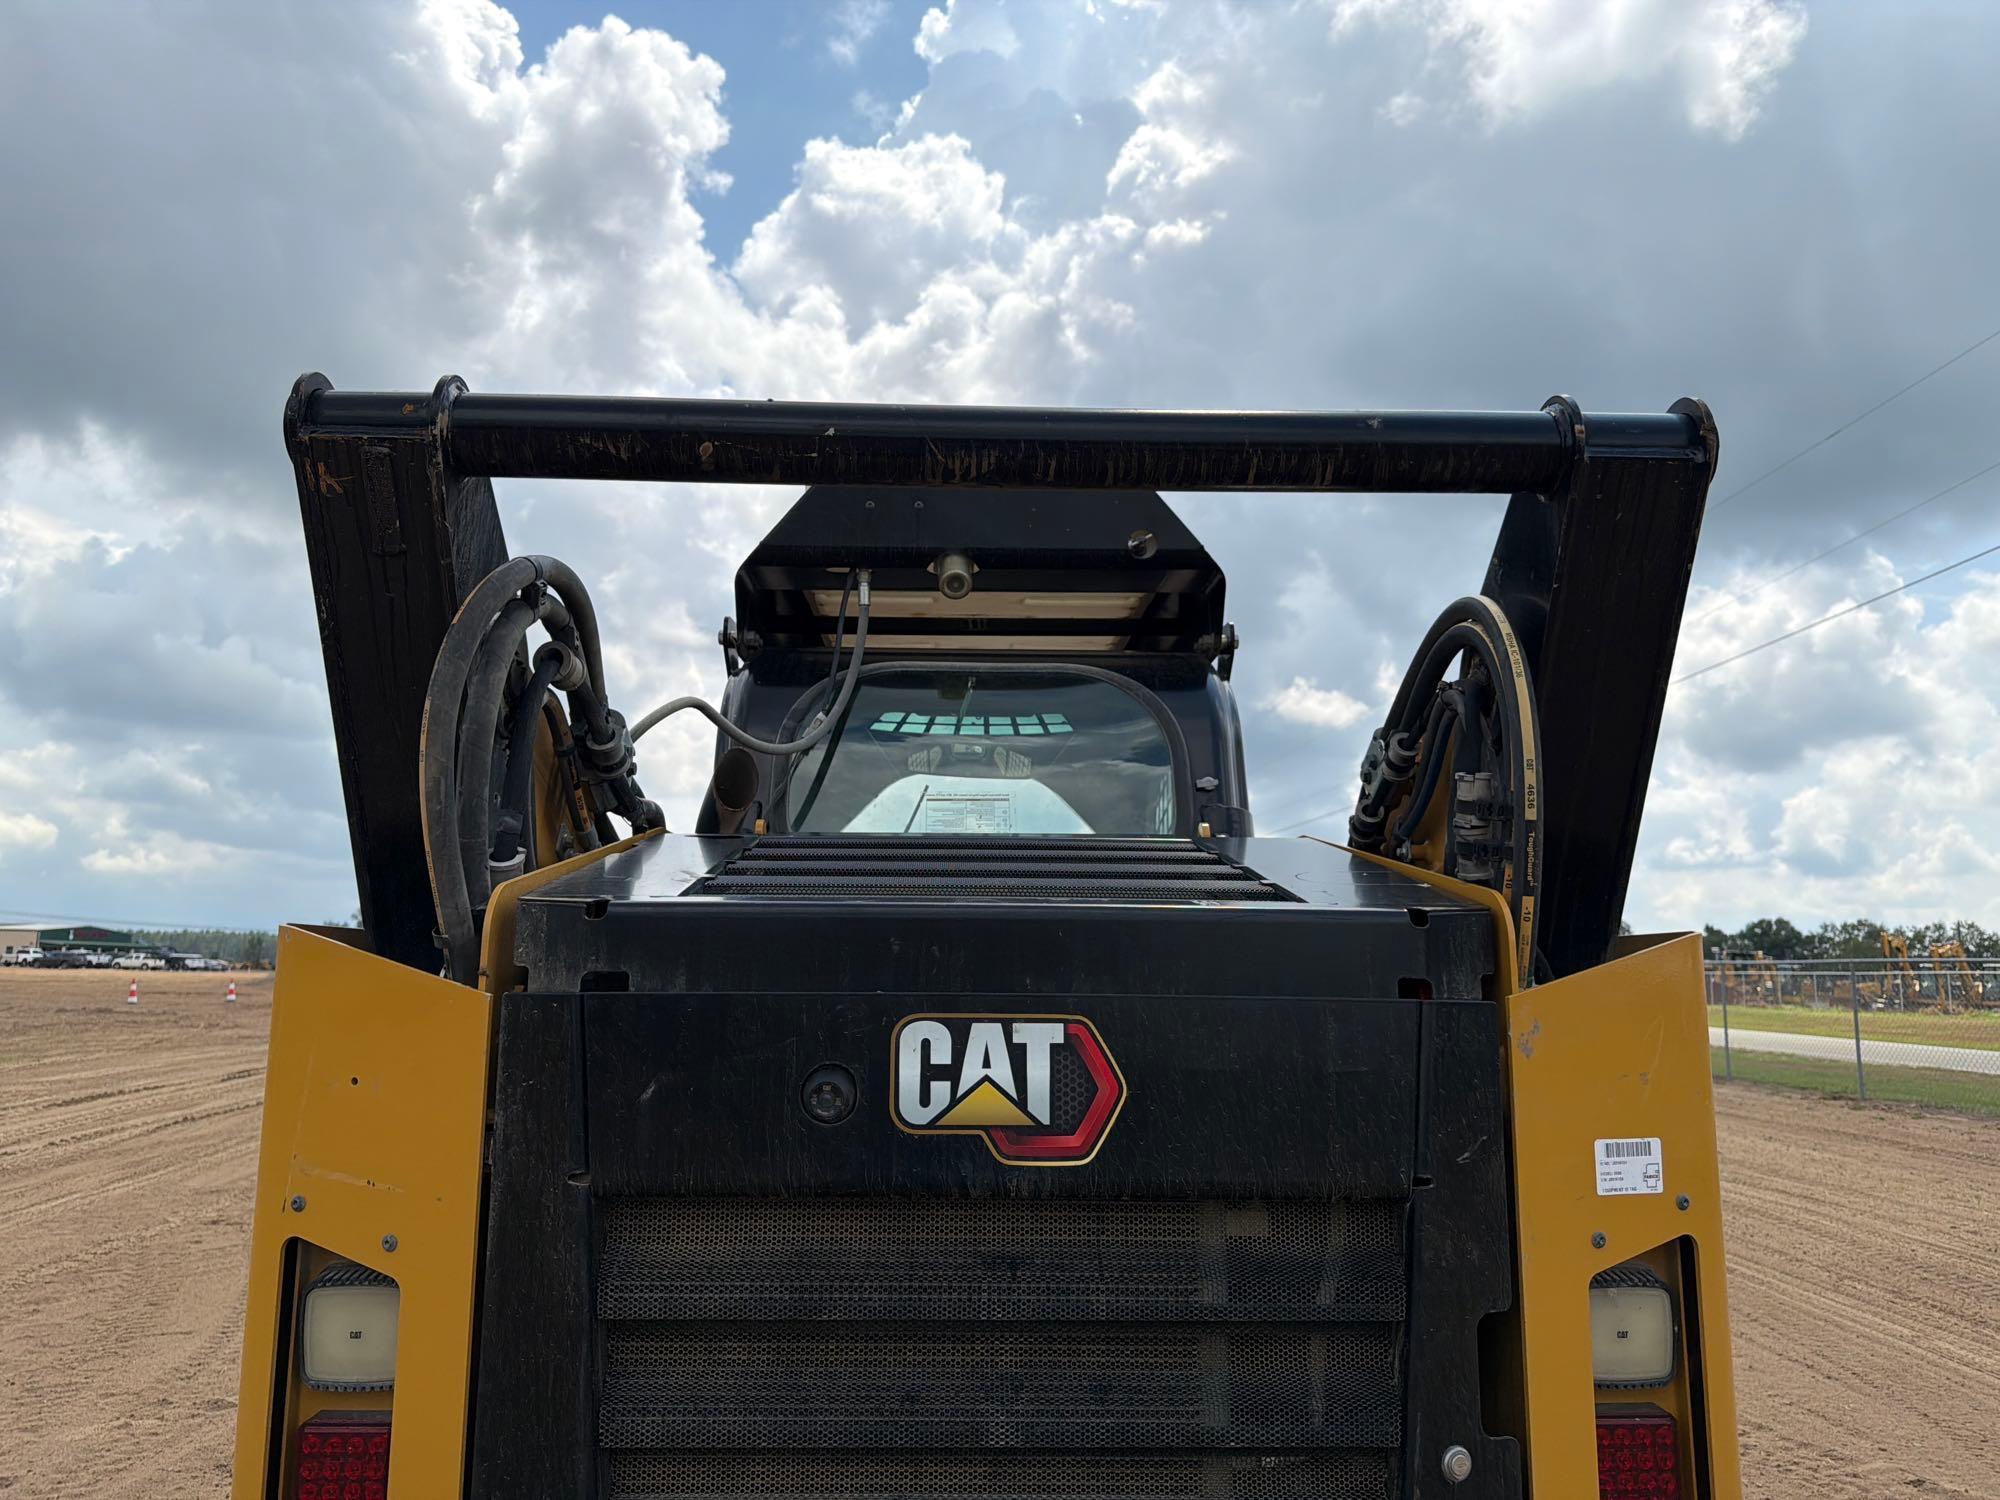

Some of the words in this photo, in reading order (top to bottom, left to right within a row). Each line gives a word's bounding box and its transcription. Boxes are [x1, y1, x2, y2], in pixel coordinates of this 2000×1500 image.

[1505, 632, 1517, 649] MSHA
[1526, 758, 1534, 771] CAT
[1527, 783, 1535, 810] 4636
[1523, 906, 1531, 922] -10
[899, 1020, 1065, 1126] CAT
[350, 1331, 362, 1339] CAT
[1617, 1331, 1629, 1339] CAT
